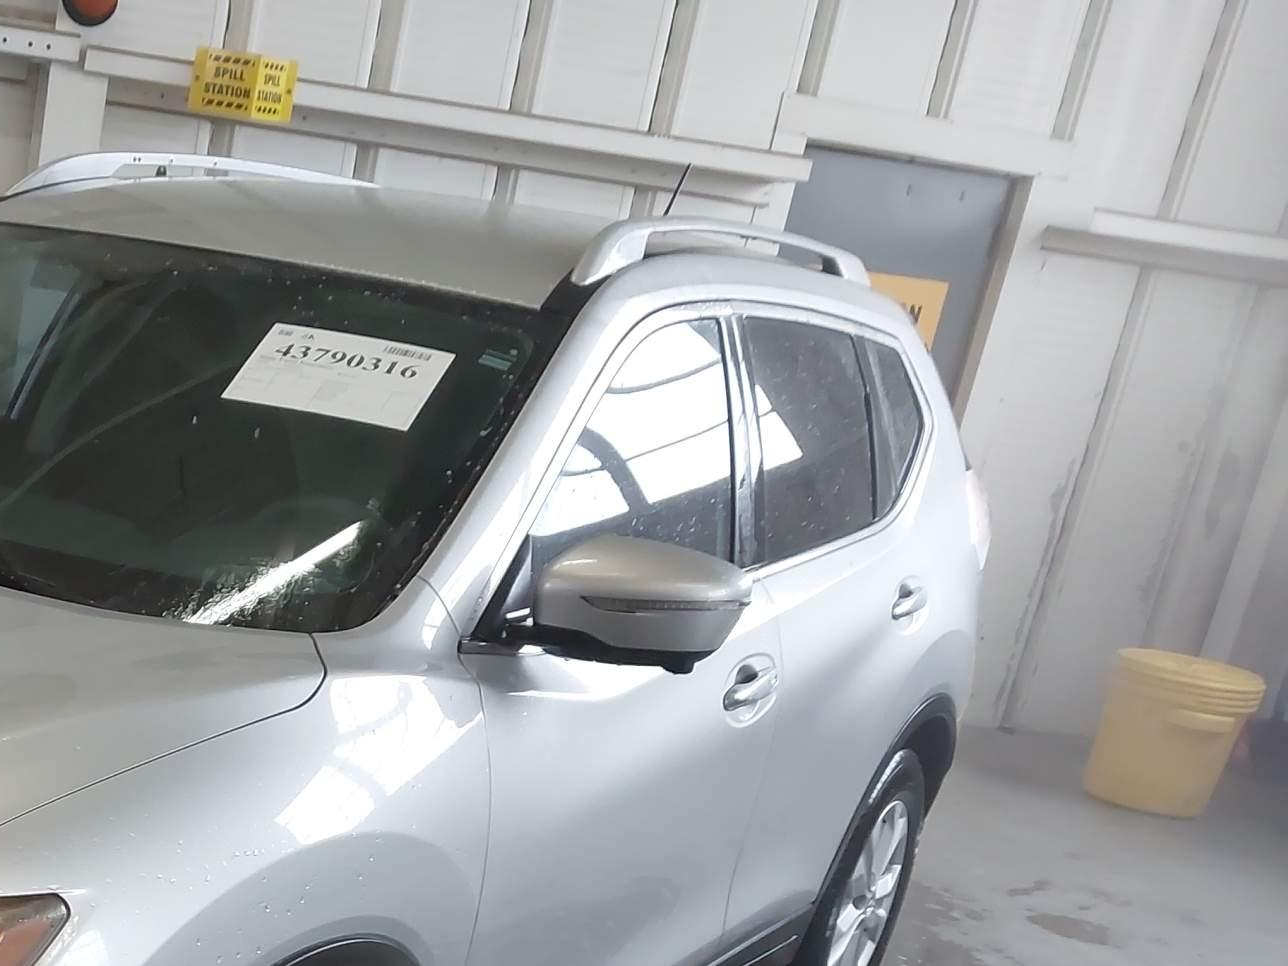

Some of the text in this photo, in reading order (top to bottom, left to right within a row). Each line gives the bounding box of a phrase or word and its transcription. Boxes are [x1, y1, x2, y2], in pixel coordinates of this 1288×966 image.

[214, 66, 245, 81] SPILL
[263, 74, 280, 87] SPILL
[204, 82, 251, 99] STATION
[257, 90, 282, 104] STATION
[275, 343, 418, 379] 43790316
